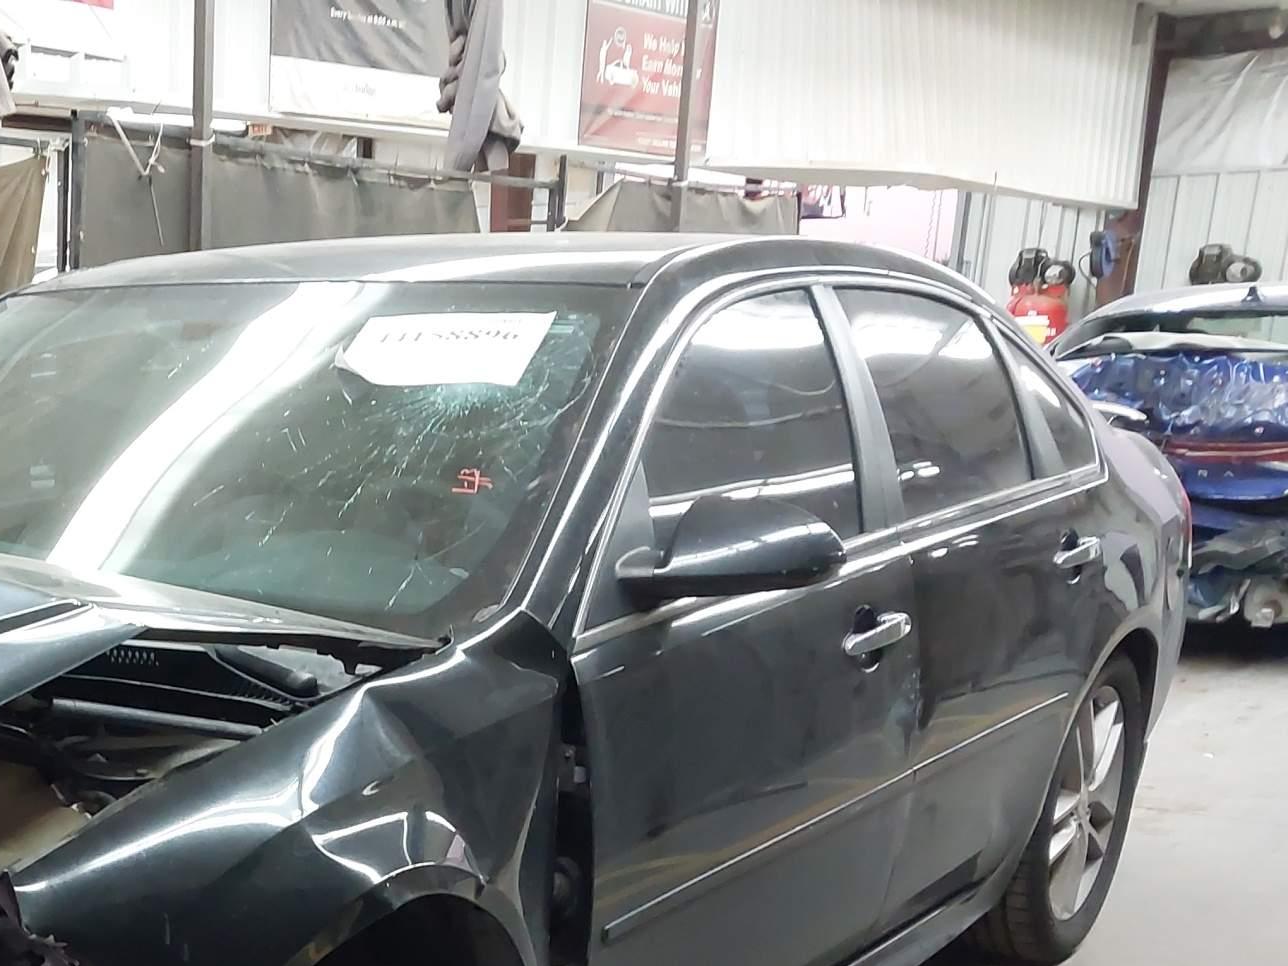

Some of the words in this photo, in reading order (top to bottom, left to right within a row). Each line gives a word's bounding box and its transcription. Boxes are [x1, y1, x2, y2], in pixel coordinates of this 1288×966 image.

[643, 32, 658, 52] We
[660, 36, 680, 57] Help
[642, 54, 663, 73] Earn
[643, 76, 659, 94] Your
